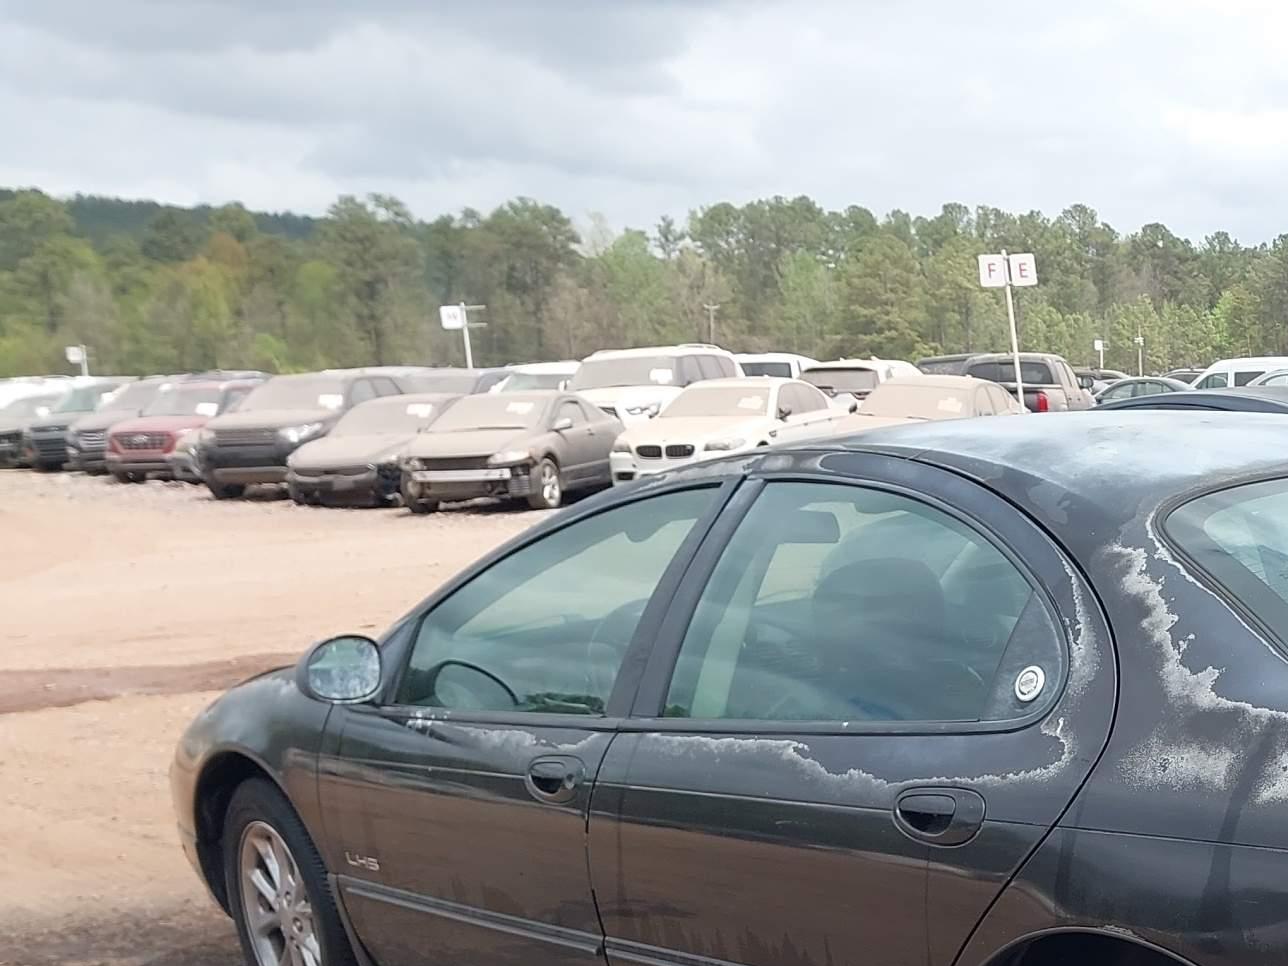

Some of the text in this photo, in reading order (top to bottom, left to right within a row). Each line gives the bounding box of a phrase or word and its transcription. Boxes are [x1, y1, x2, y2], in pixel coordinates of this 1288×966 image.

[988, 262, 997, 278] F
[1018, 262, 1029, 278] E
[344, 851, 380, 871] LHS
